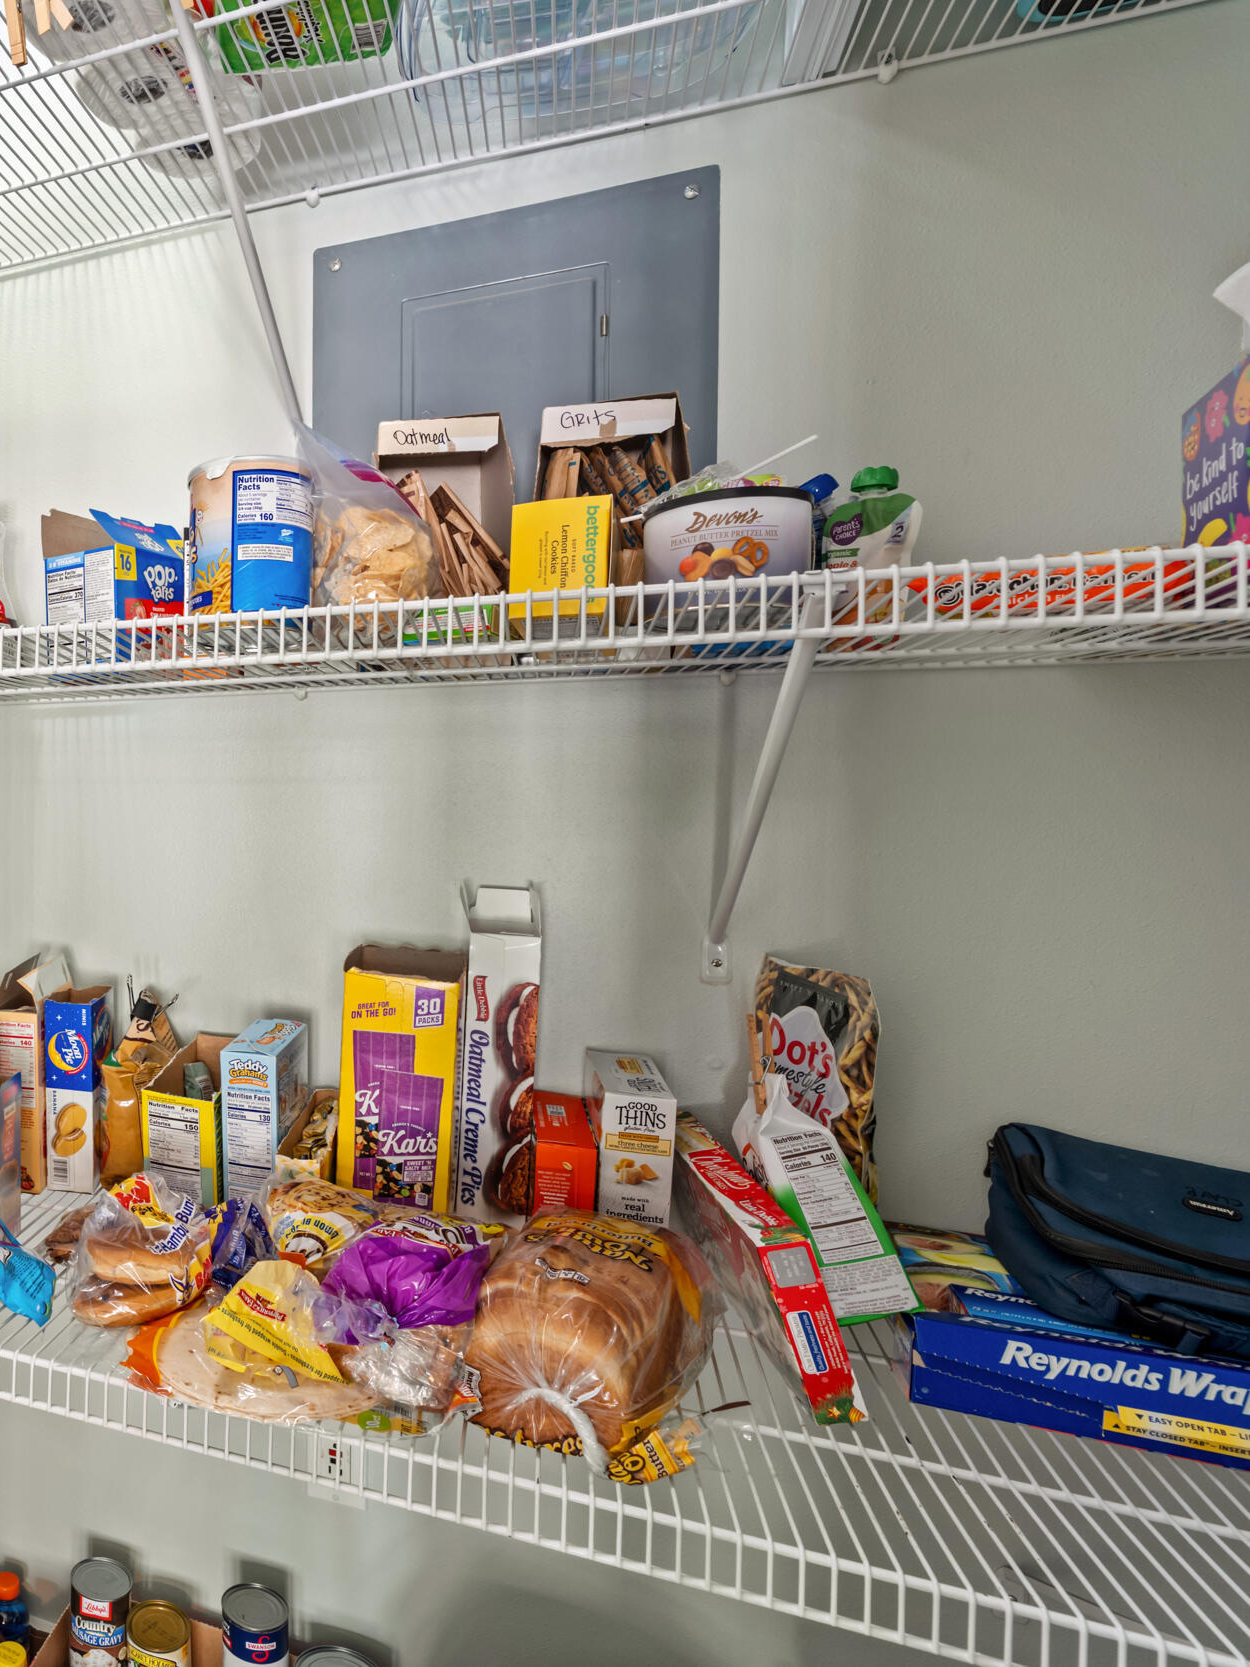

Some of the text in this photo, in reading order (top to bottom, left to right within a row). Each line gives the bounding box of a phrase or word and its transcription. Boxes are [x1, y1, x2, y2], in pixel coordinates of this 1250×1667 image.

[393, 427, 451, 446] Oatmeal
[1186, 437, 1245, 499] be kind to
[237, 475, 275, 484] Nutrition
[237, 483, 261, 491] Facts
[1189, 470, 1239, 532] yourself
[259, 512, 274, 521] 160
[670, 528, 780, 548] PEANUT BUTTER PRETZEL MIX
[892, 525, 904, 539] 2
[119, 553, 133, 572] 16
[549, 539, 561, 575] Cookies
[559, 524, 570, 589] Lemon Chiffon
[350, 1007, 397, 1019] ON THE GO!
[357, 1000, 390, 1010] GREAT FOR
[417, 997, 441, 1014] 30
[417, 1016, 440, 1025] PACKS
[64, 1028, 83, 1060] Moon
[61, 1047, 74, 1065] Pie
[229, 1059, 268, 1074] Teddy
[229, 1069, 268, 1082] Grahams
[227, 1092, 271, 1102] Nutrition Facts
[148, 1101, 199, 1114] Nutrition Facts
[627, 1101, 658, 1112] GOOD
[227, 1112, 271, 1122] Calories 130
[461, 1028, 490, 1207] Oatmeal Creme Pies
[615, 1105, 667, 1130] THINS
[183, 1123, 199, 1131] 150
[772, 1131, 822, 1145] Nutrition Facts
[784, 1152, 837, 1170] Calories 140
[624, 1203, 646, 1213] real
[605, 1209, 664, 1225] ingredients
[221, 1307, 272, 1346] wrapped for freshness
[999, 1338, 1164, 1392] Reynolds
[1148, 1415, 1228, 1437] EASY OPEN TAB
[1125, 1425, 1149, 1437] STAY
[1149, 1429, 1186, 1444] CLOSED
[74, 1615, 117, 1637] Country
[98, 1632, 124, 1647] GRAVY
